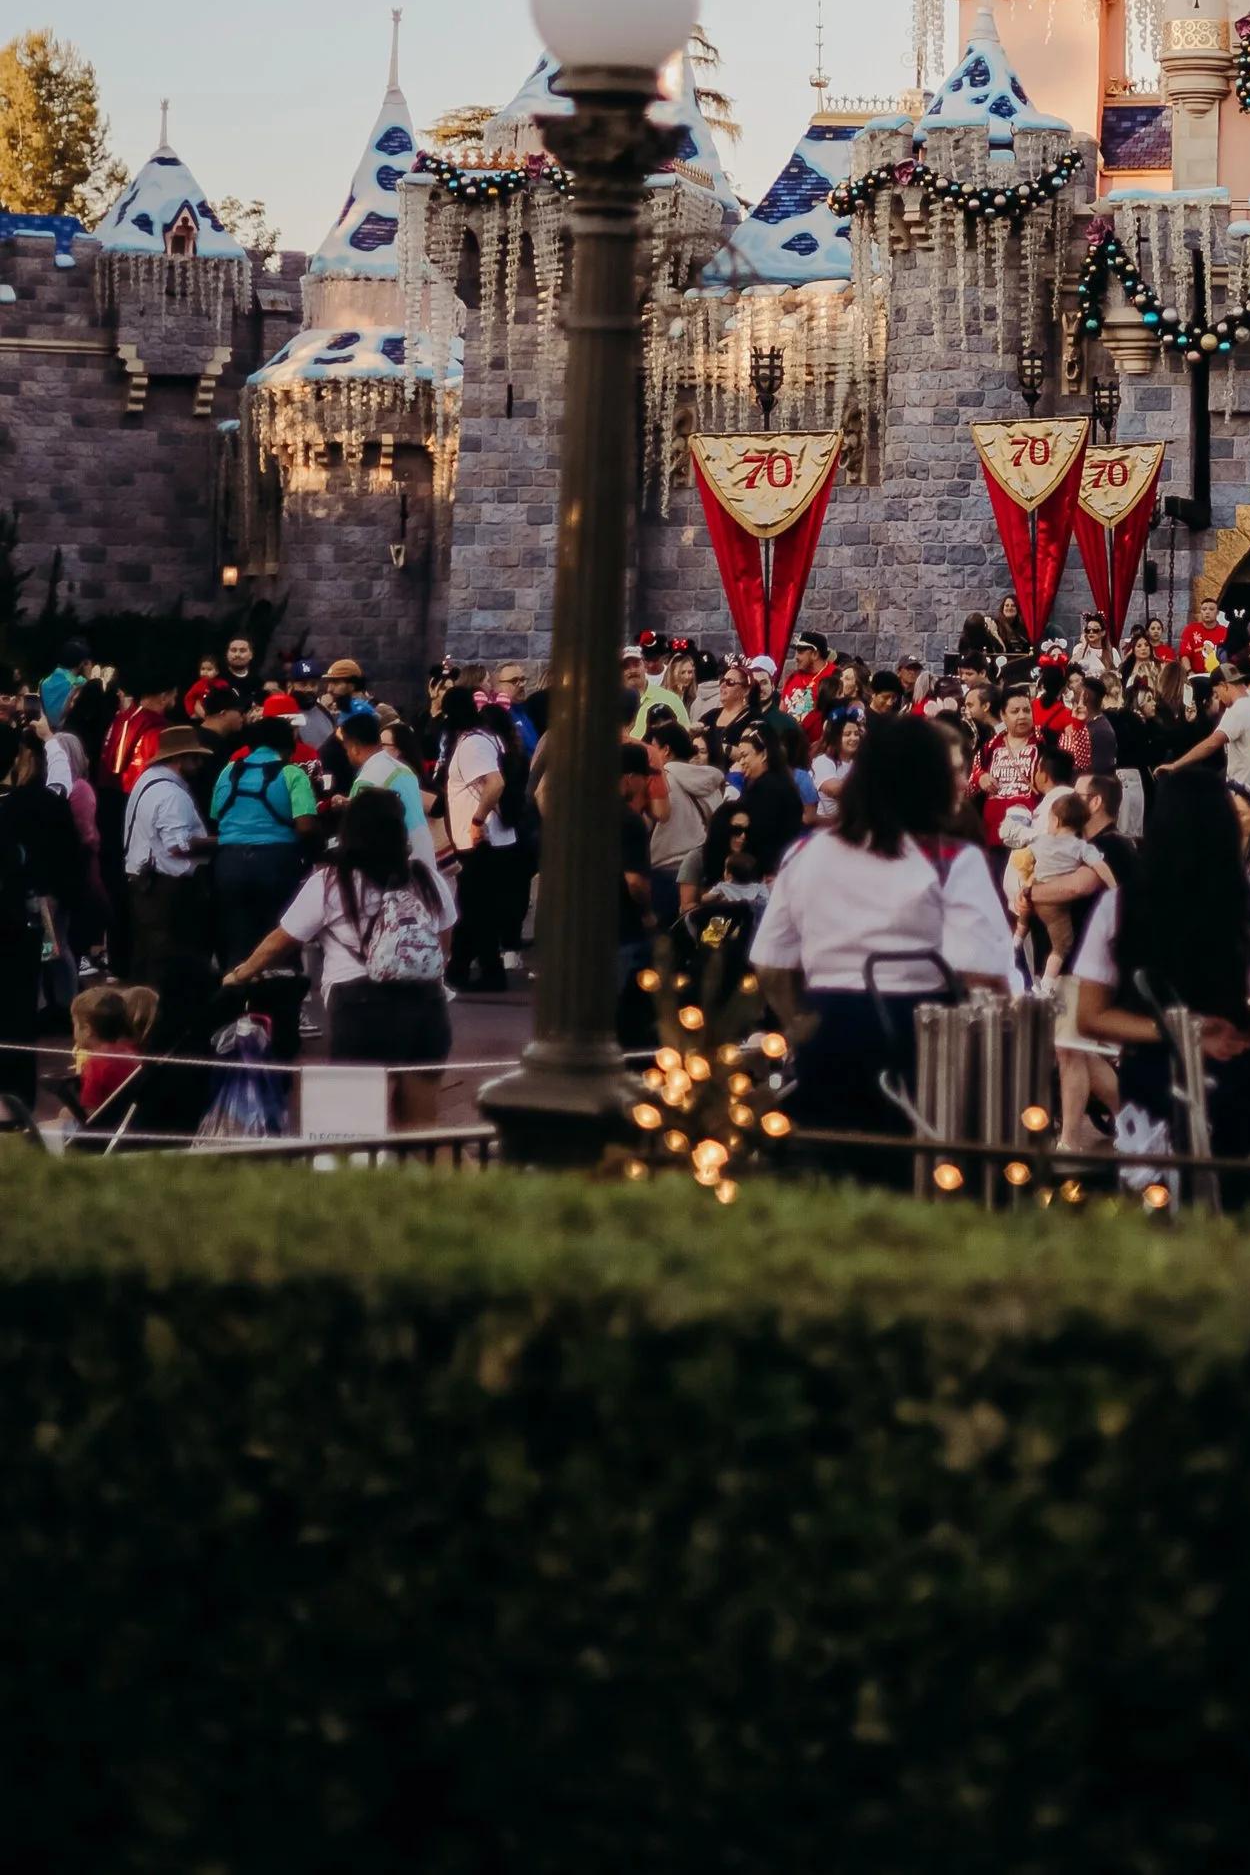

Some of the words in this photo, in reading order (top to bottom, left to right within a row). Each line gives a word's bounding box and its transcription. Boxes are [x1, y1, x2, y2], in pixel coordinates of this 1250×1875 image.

[1010, 437, 1051, 467] 70
[743, 454, 793, 489] 70
[1089, 460, 1129, 489] 70
